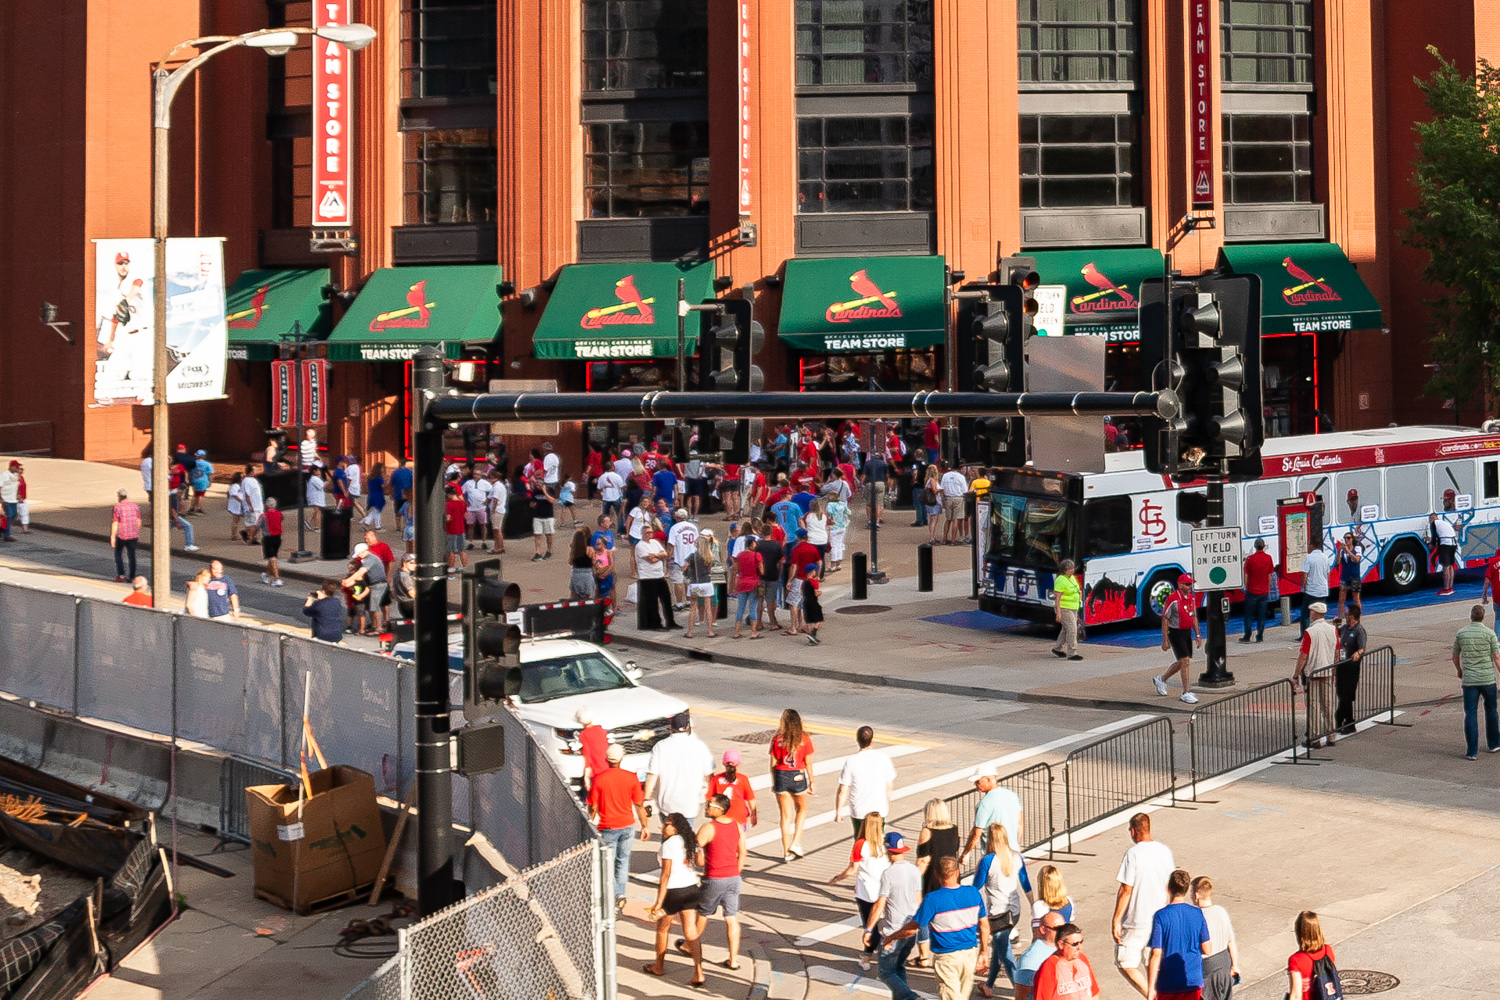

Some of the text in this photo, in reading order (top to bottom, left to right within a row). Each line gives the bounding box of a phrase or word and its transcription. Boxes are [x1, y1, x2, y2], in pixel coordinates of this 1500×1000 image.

[325, 4, 340, 75] TAM
[1197, 63, 1207, 151] STORE
[325, 83, 341, 173] STORE
[825, 303, 902, 323] Cardinals
[1039, 303, 1055, 314] ELD
[1292, 319, 1352, 332] TEAM STORE
[1109, 329, 1140, 342] STOR
[824, 337, 906, 350] TEAM STORE
[228, 350, 249, 360] TORE
[360, 349, 421, 360] TEAM STOR
[574, 345, 654, 357] TEAM STORE
[1290, 456, 1312, 472] Louis
[1311, 453, 1342, 469] Cardinals
[682, 533, 695, 545] 50
[1195, 531, 1237, 541] LEFT TURN
[1202, 542, 1231, 554] YIELD
[1196, 555, 1238, 566] ON GREEN
[784, 752, 796, 768] 4
